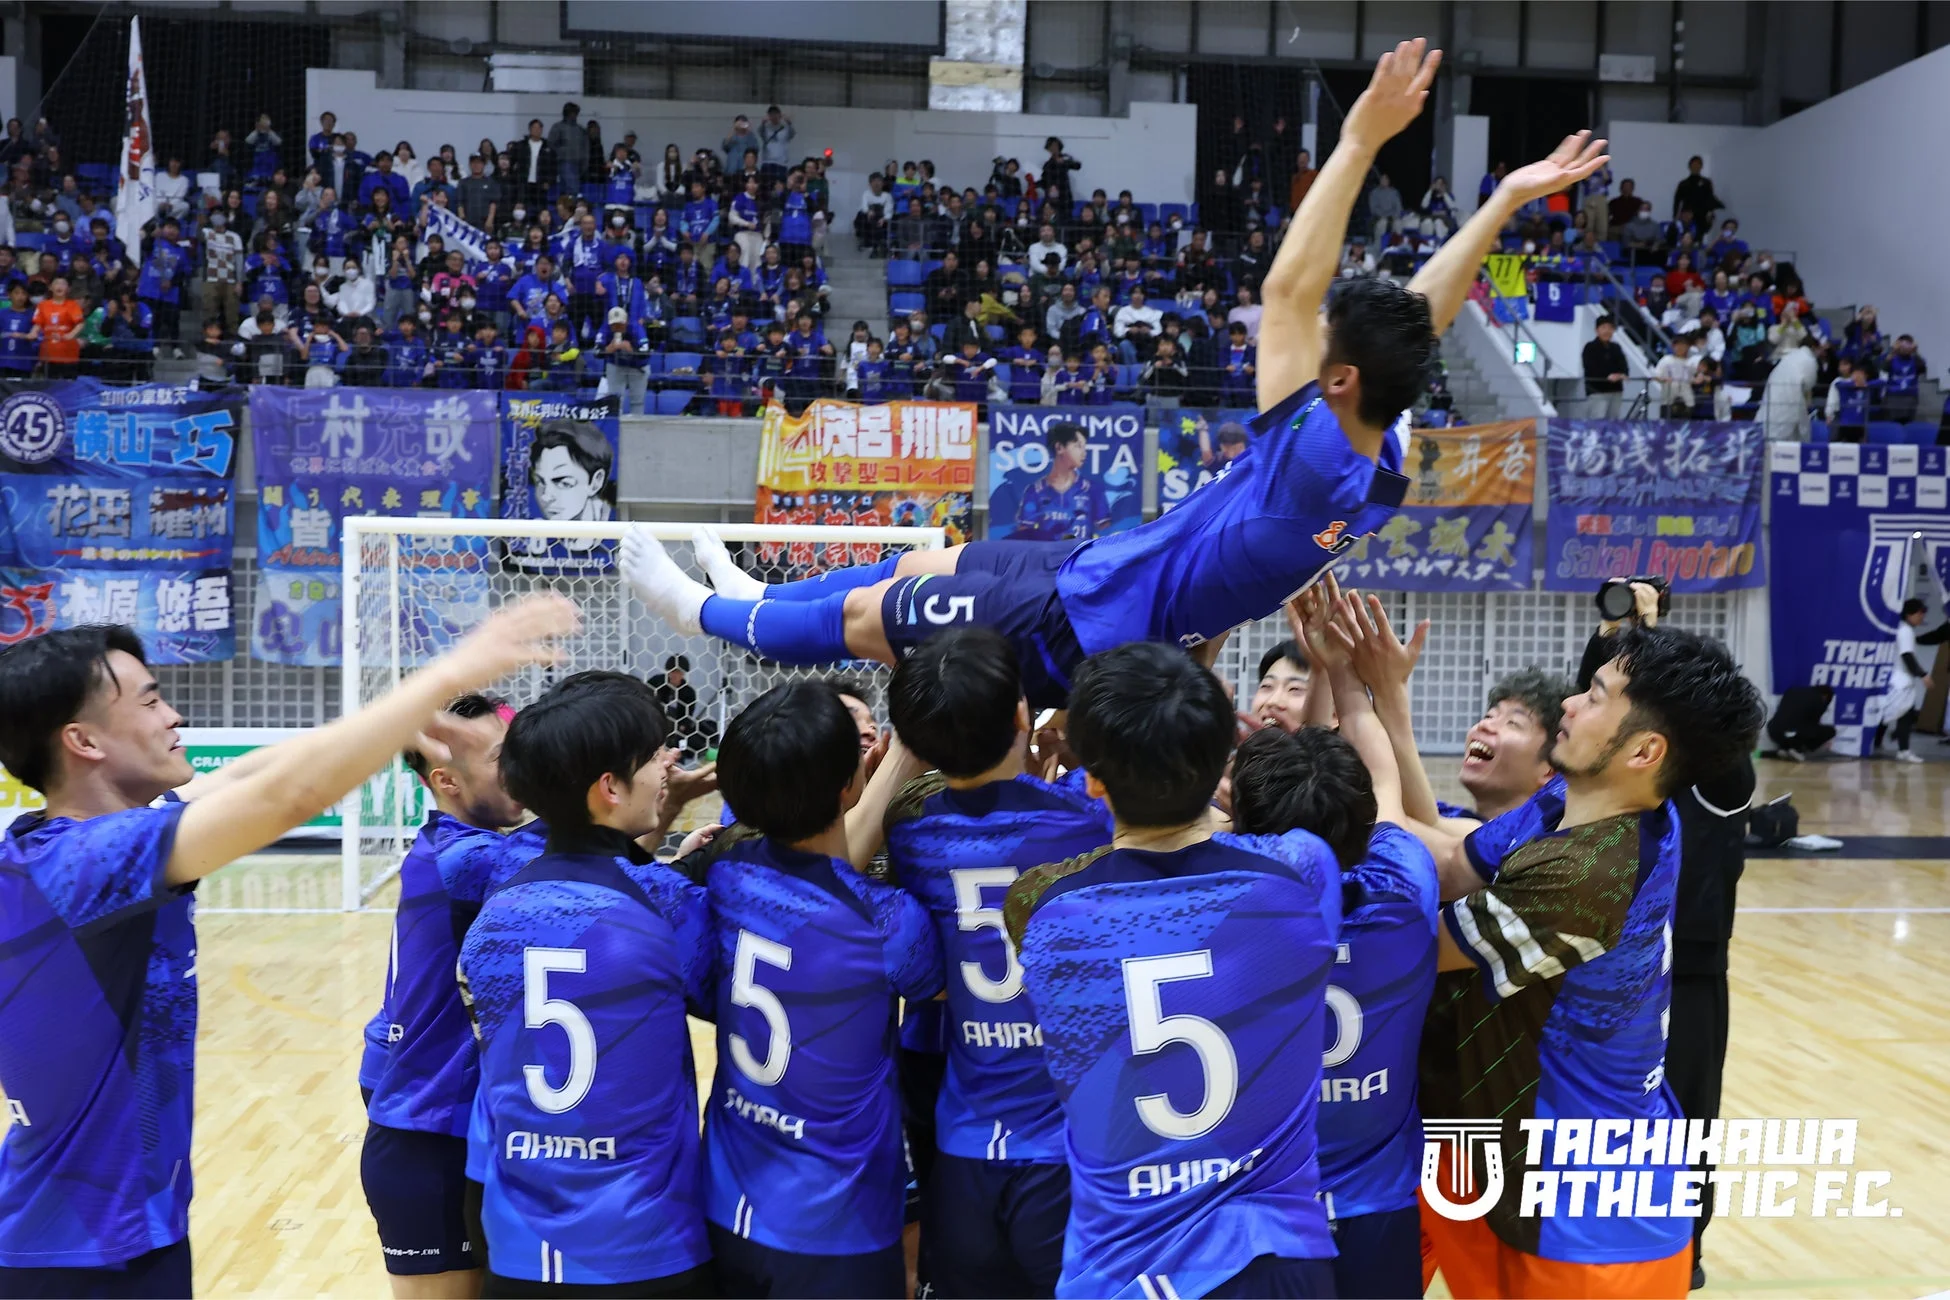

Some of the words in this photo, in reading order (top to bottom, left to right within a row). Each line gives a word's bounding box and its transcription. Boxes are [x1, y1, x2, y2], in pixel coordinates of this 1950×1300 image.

[10, 412, 48, 442] 45
[73, 411, 153, 467] 横山
[171, 410, 234, 477] 巧
[47, 484, 131, 539] 花田
[923, 594, 975, 625] 5
[950, 866, 1025, 1003] 5
[523, 946, 598, 1115] 5
[729, 928, 792, 1087] 5
[1121, 948, 1239, 1141] 5
[505, 1130, 617, 1161] AKIRA
